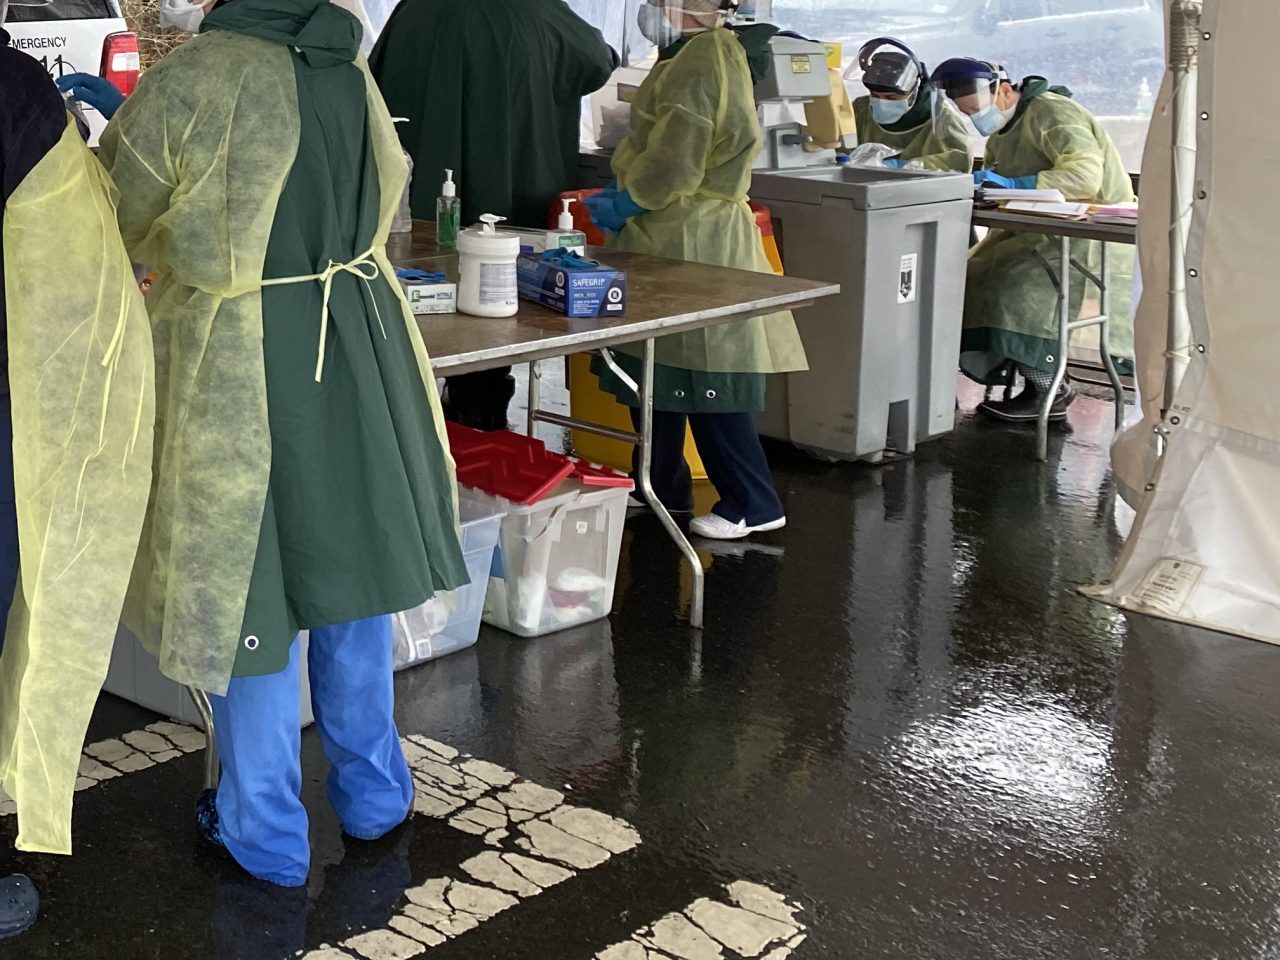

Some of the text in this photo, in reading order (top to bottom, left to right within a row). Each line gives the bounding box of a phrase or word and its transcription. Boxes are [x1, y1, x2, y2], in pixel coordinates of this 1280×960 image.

[8, 37, 67, 49] MERGENCY
[39, 54, 63, 77] 11
[572, 277, 606, 288] SAFEGRIP
